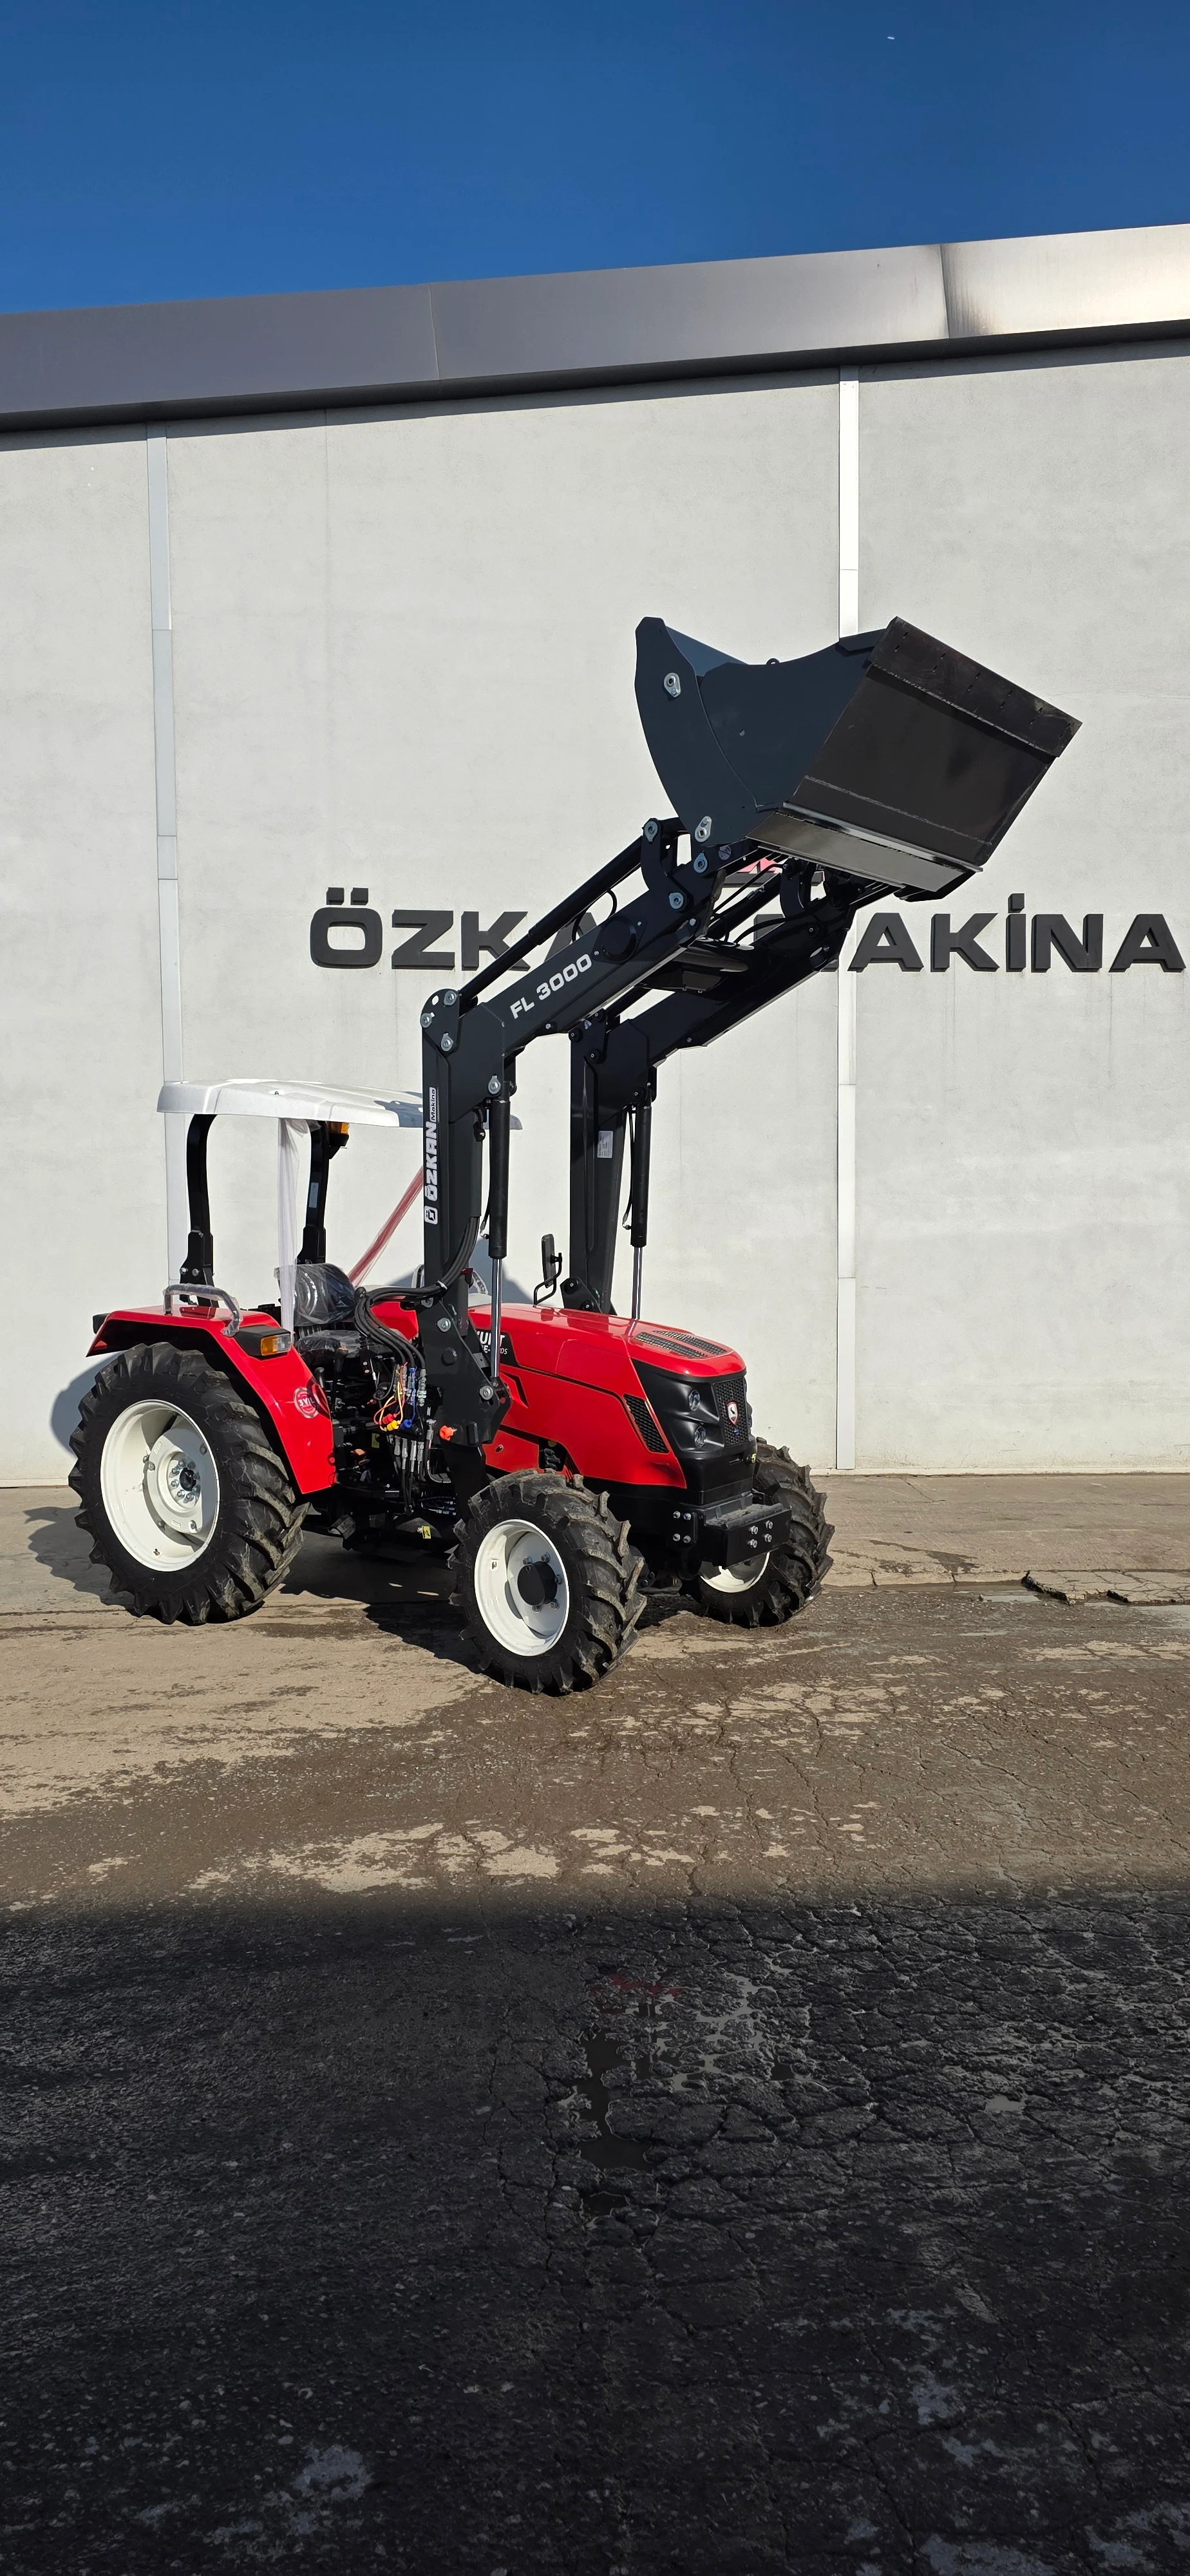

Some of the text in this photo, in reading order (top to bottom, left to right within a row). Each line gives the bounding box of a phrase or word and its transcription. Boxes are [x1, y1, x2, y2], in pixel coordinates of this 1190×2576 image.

[754, 893, 1187, 972] AKİNA
[509, 954, 592, 1019] FL 3000
[424, 1121, 438, 1202] ÖZKAN
